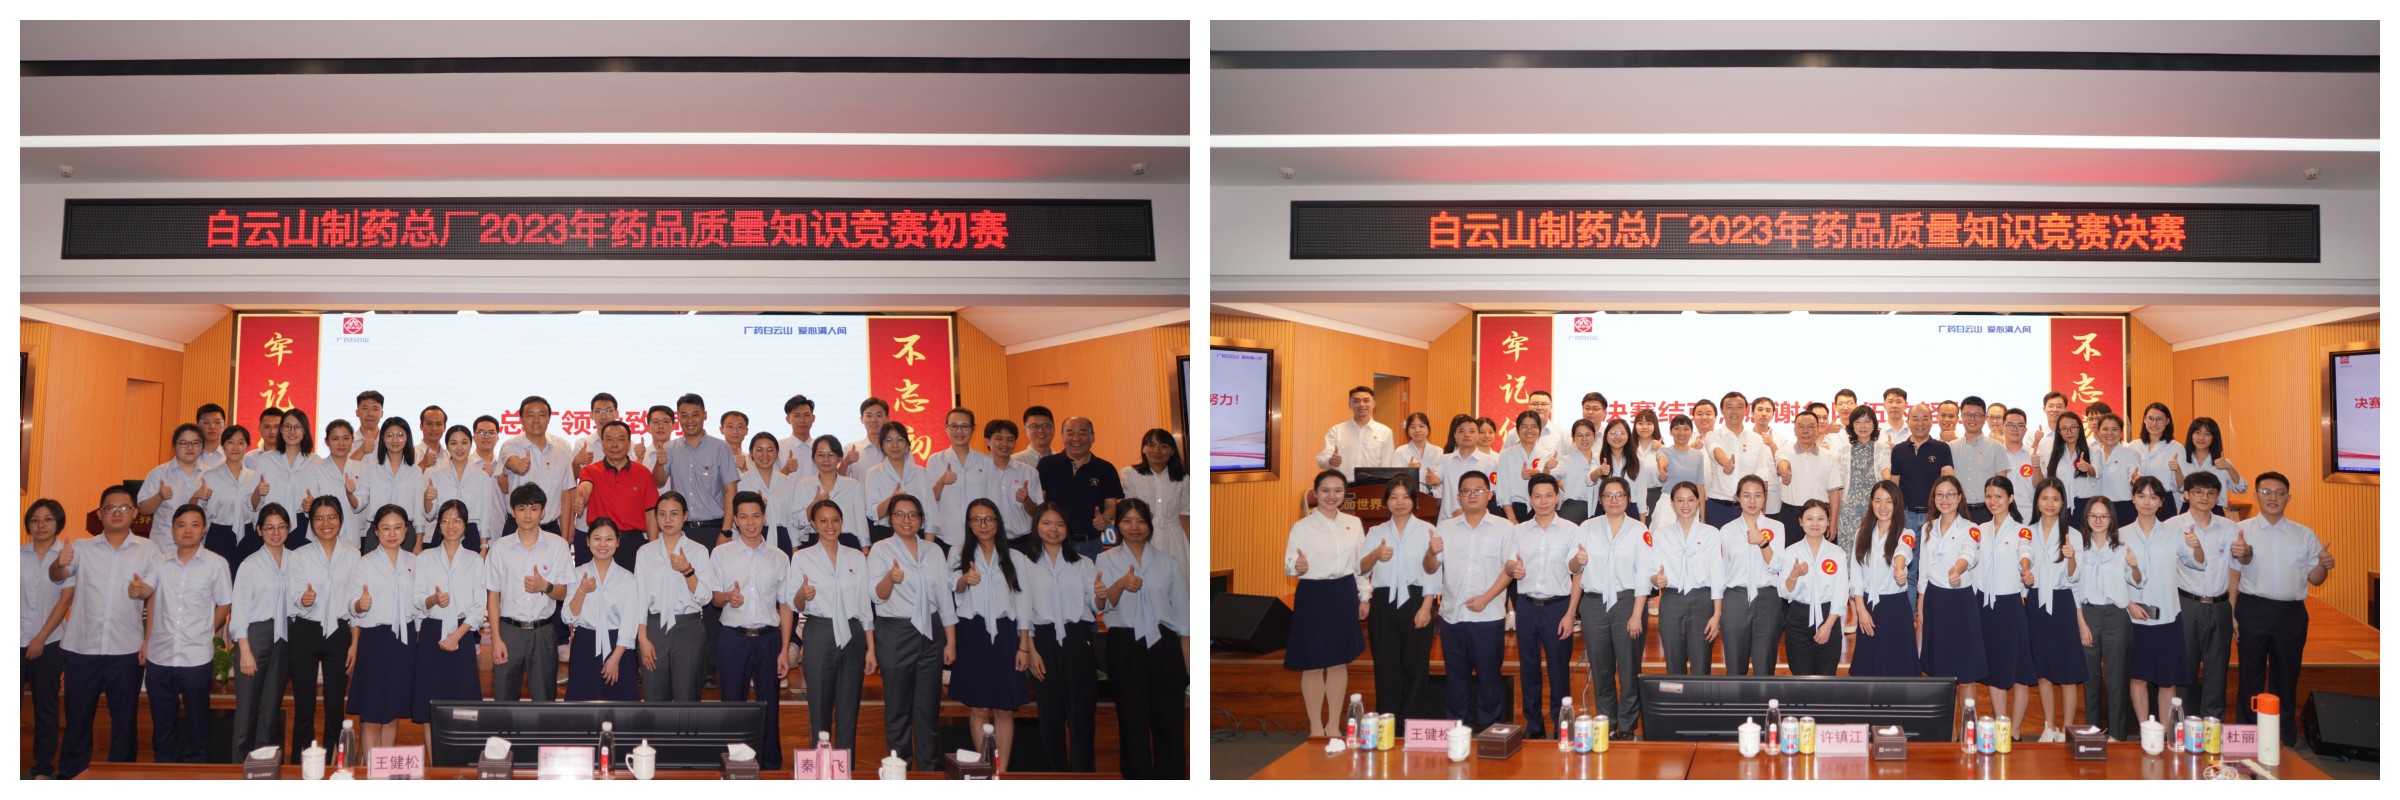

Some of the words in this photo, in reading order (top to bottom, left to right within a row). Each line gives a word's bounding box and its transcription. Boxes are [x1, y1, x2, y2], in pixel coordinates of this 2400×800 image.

[207, 209, 1008, 249] 白云山制药总厂2023年药品质量知识竞赛初赛
[1430, 210, 2186, 251] 白云山制药总厂2023年药品质量知识竞赛决赛
[258, 332, 295, 448] 牢记
[2071, 333, 2103, 438] 不忘
[2023, 466, 2031, 476] 2
[2024, 529, 2032, 539] 2
[1825, 561, 1835, 573] 2
[1820, 729, 1864, 744] 许镇江
[2226, 729, 2258, 744] 杜丽
[374, 754, 419, 770] 王健松
[801, 758, 845, 773] 秦飞
